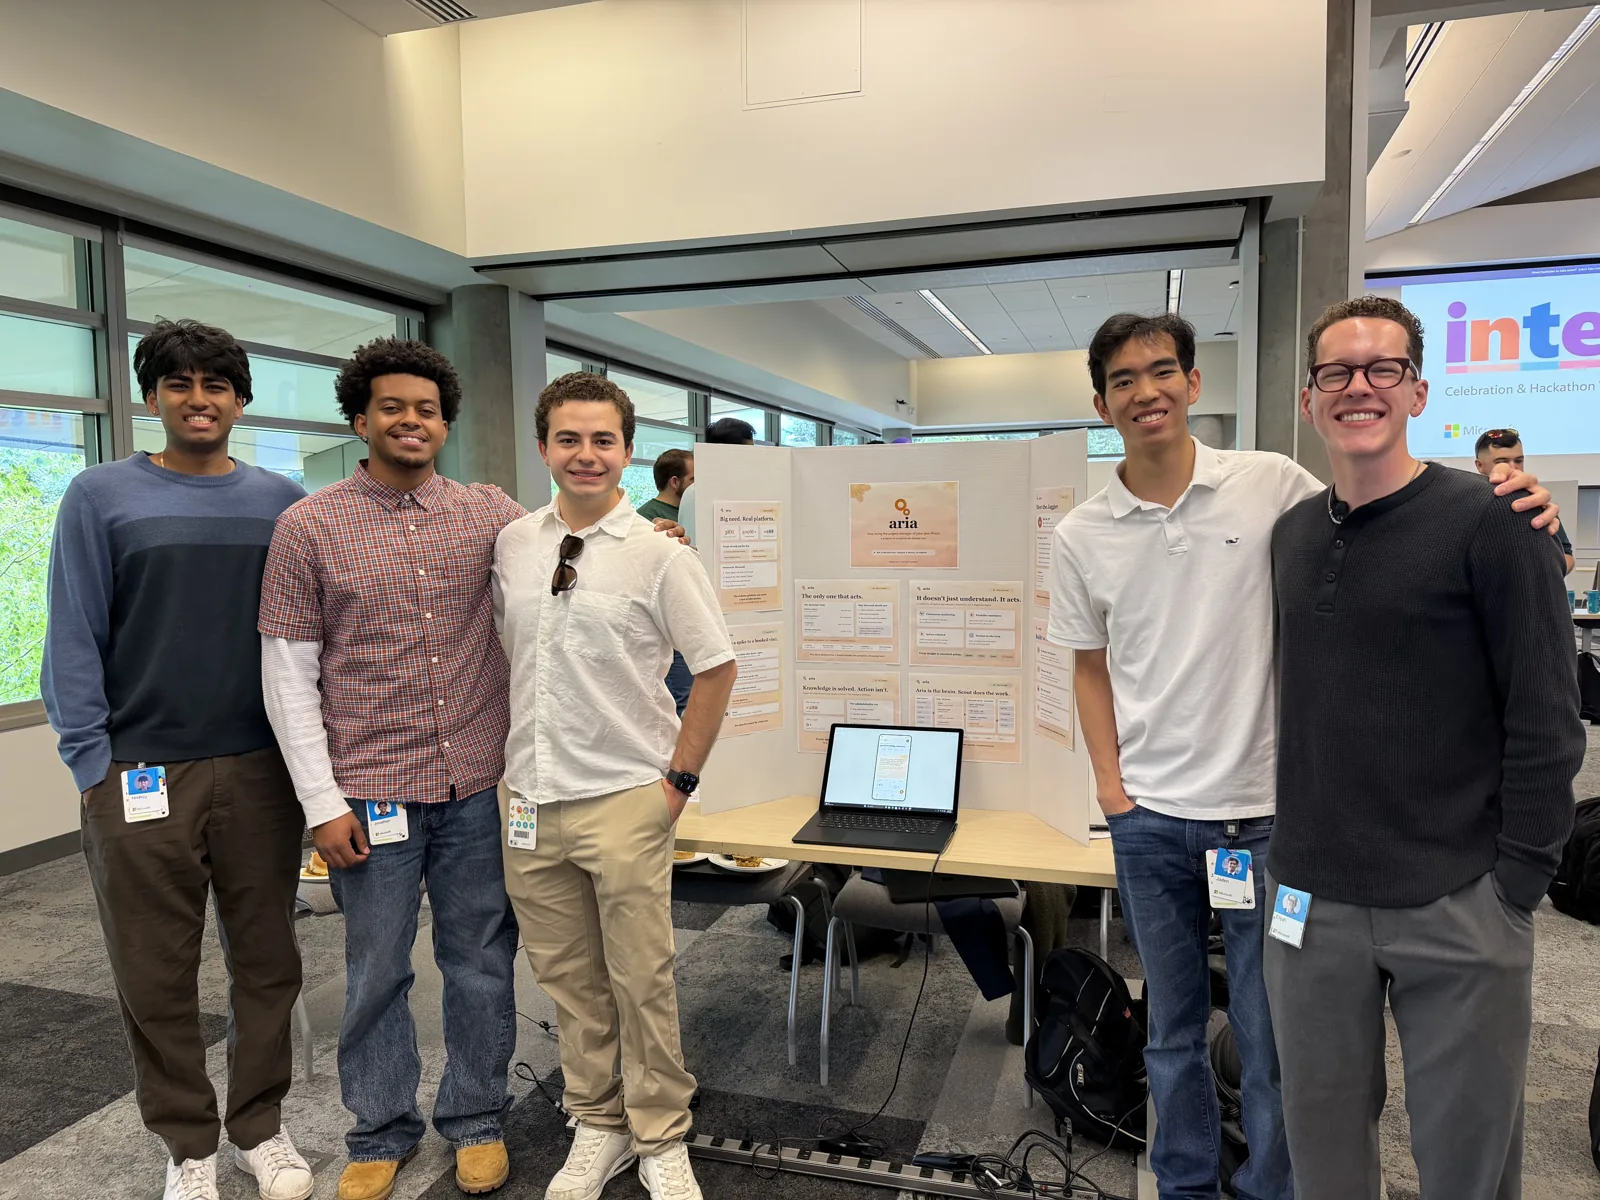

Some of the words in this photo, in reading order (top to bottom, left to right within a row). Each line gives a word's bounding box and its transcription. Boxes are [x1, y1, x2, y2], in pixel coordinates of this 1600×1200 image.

[1446, 301, 1600, 363] inte
[1445, 383, 1513, 397] Celebration
[1517, 384, 1527, 394] &
[1530, 381, 1596, 393] Hackathon
[889, 516, 918, 528] aria
